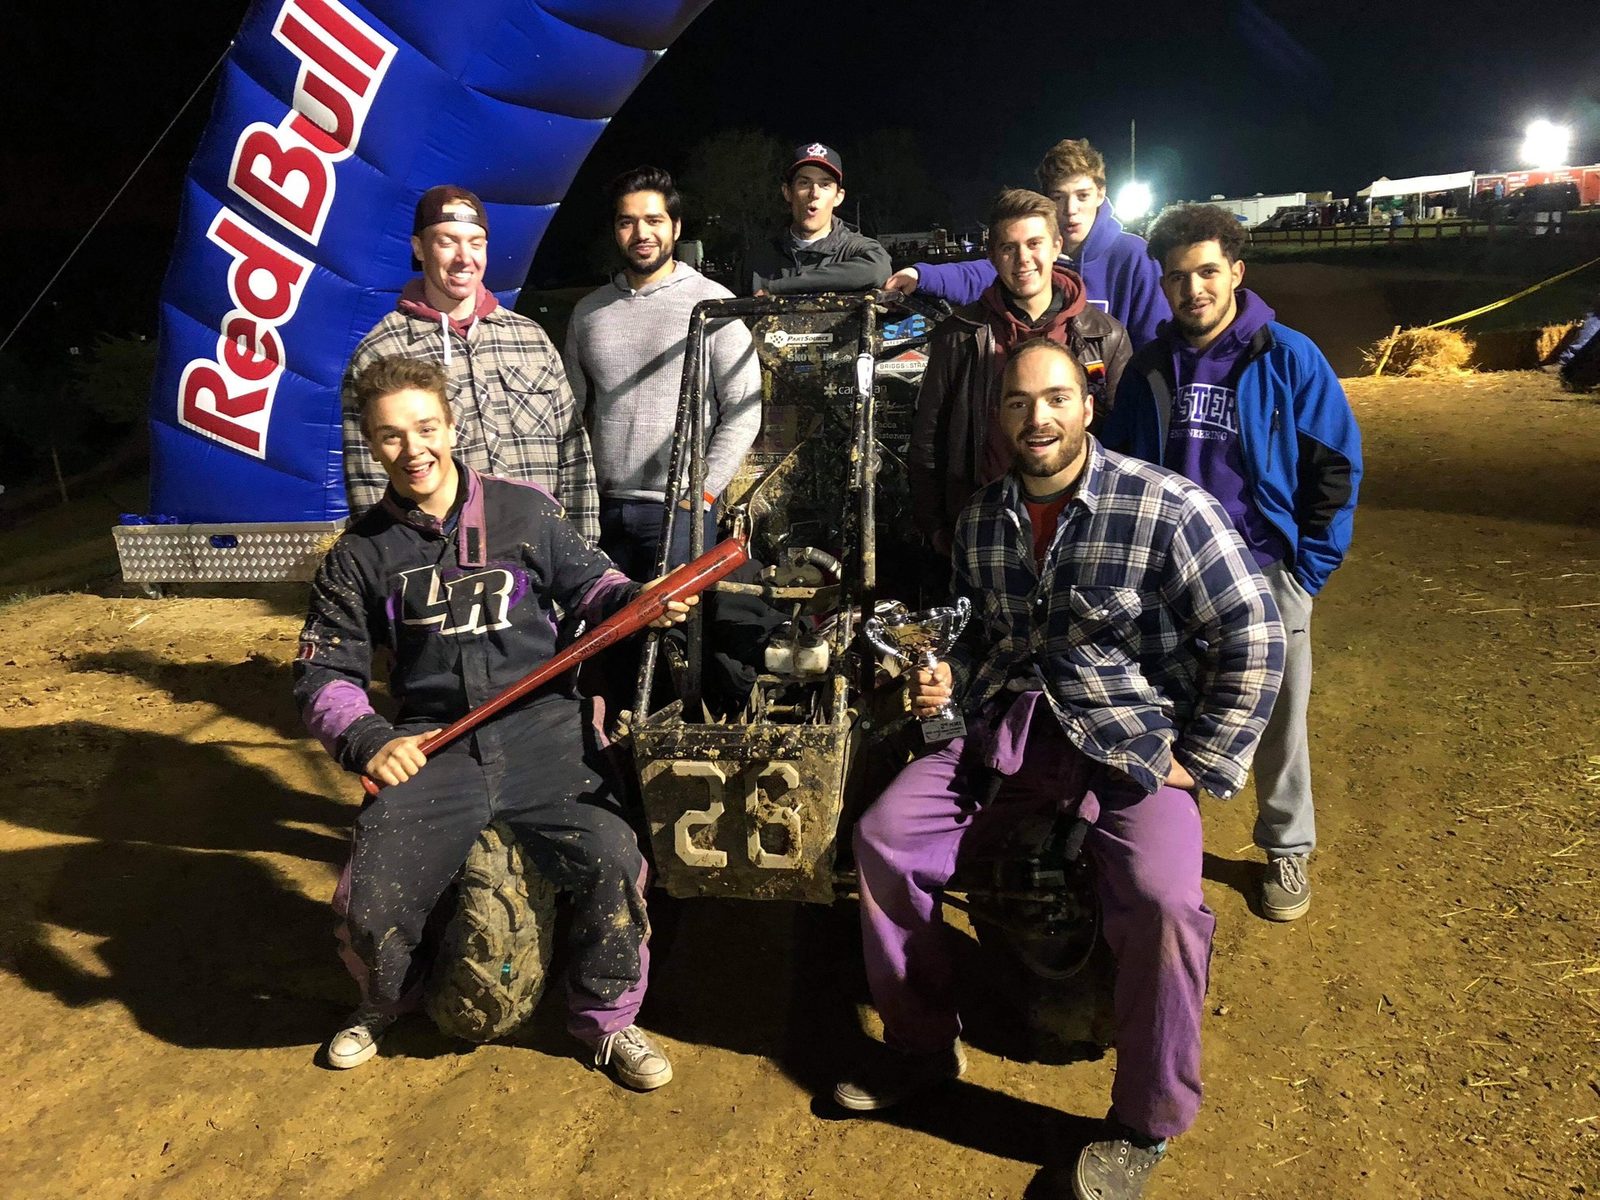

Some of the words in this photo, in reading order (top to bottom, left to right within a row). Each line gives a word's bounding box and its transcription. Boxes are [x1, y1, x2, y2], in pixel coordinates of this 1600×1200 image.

[230, 0, 392, 241] Bull
[180, 211, 310, 456] Red
[1170, 429, 1227, 441] ENNEERING
[1176, 383, 1238, 433] STER
[399, 564, 514, 635] LR
